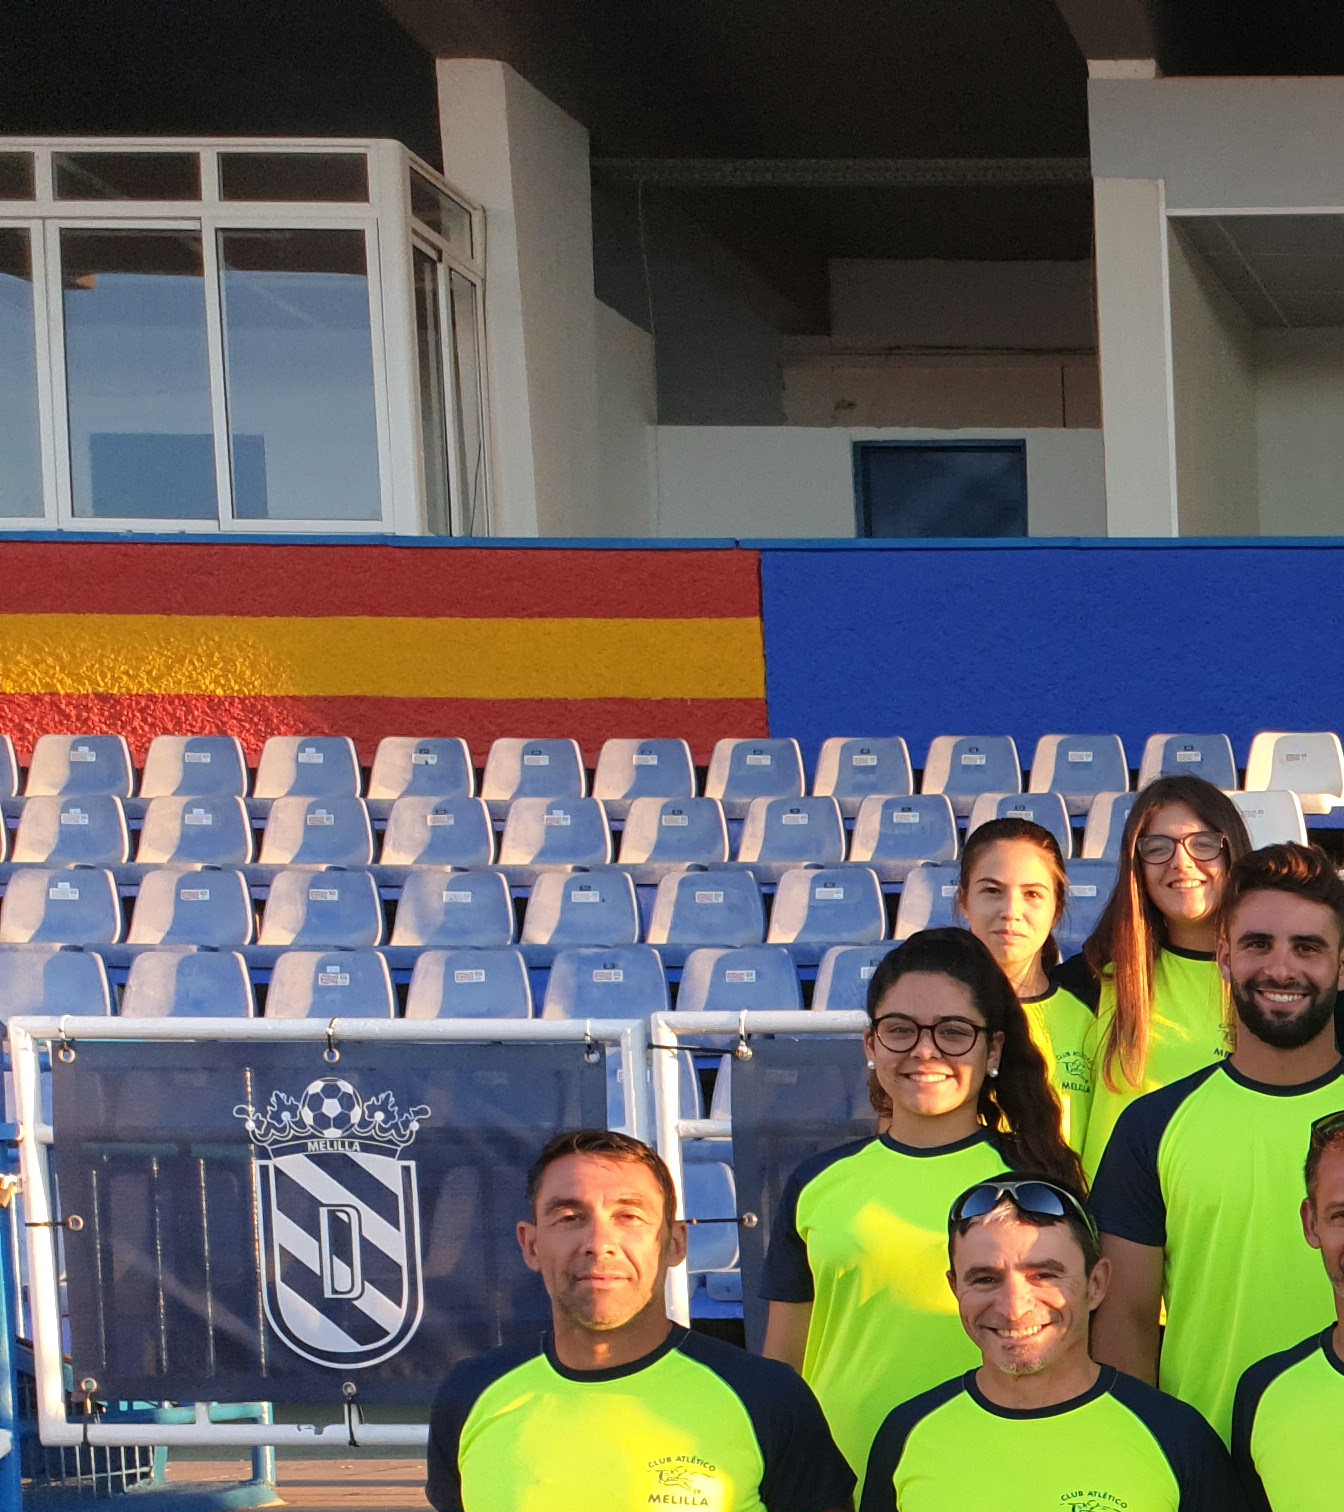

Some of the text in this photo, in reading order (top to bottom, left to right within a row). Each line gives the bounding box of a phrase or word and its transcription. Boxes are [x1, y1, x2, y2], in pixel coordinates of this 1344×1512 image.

[307, 1140, 361, 1153] MELILLA
[648, 1455, 716, 1472] CLUB ATLÉTICO
[647, 1493, 709, 1506] MELILLA
[1060, 1490, 1128, 1508] CLUB ATLÉTICO
